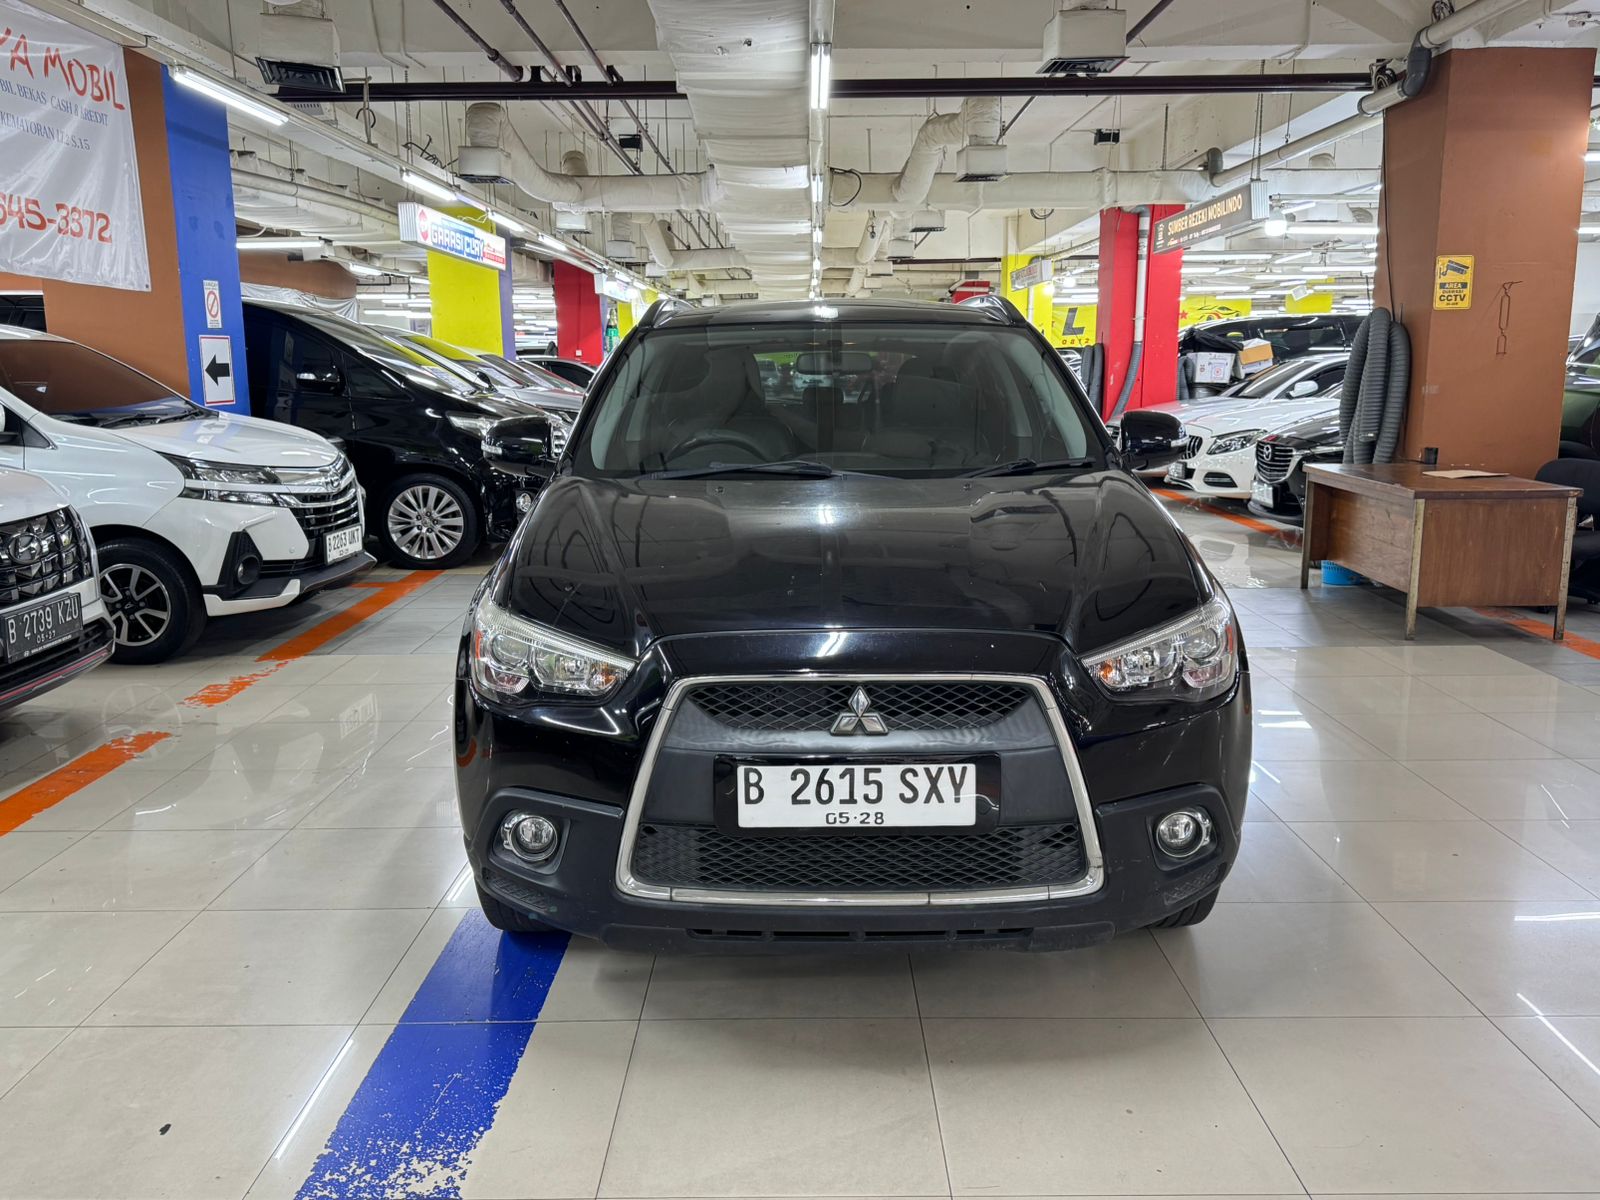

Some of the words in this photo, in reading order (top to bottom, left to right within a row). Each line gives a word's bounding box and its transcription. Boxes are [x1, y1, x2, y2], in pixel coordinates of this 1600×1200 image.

[44, 47, 125, 110] MOBIL
[17, 84, 46, 105] BEKAS
[51, 96, 73, 115] CASH
[1168, 215, 1188, 235] SUMBER
[1189, 207, 1207, 228] REZEKI
[1208, 193, 1242, 221] MOBILINDO
[1439, 294, 1466, 302] CCTV
[8, 619, 17, 644] B
[23, 607, 53, 638] 2739
[57, 597, 79, 624] KZU
[744, 767, 765, 805] B
[790, 767, 884, 805] 2615
[899, 766, 968, 804] SXY
